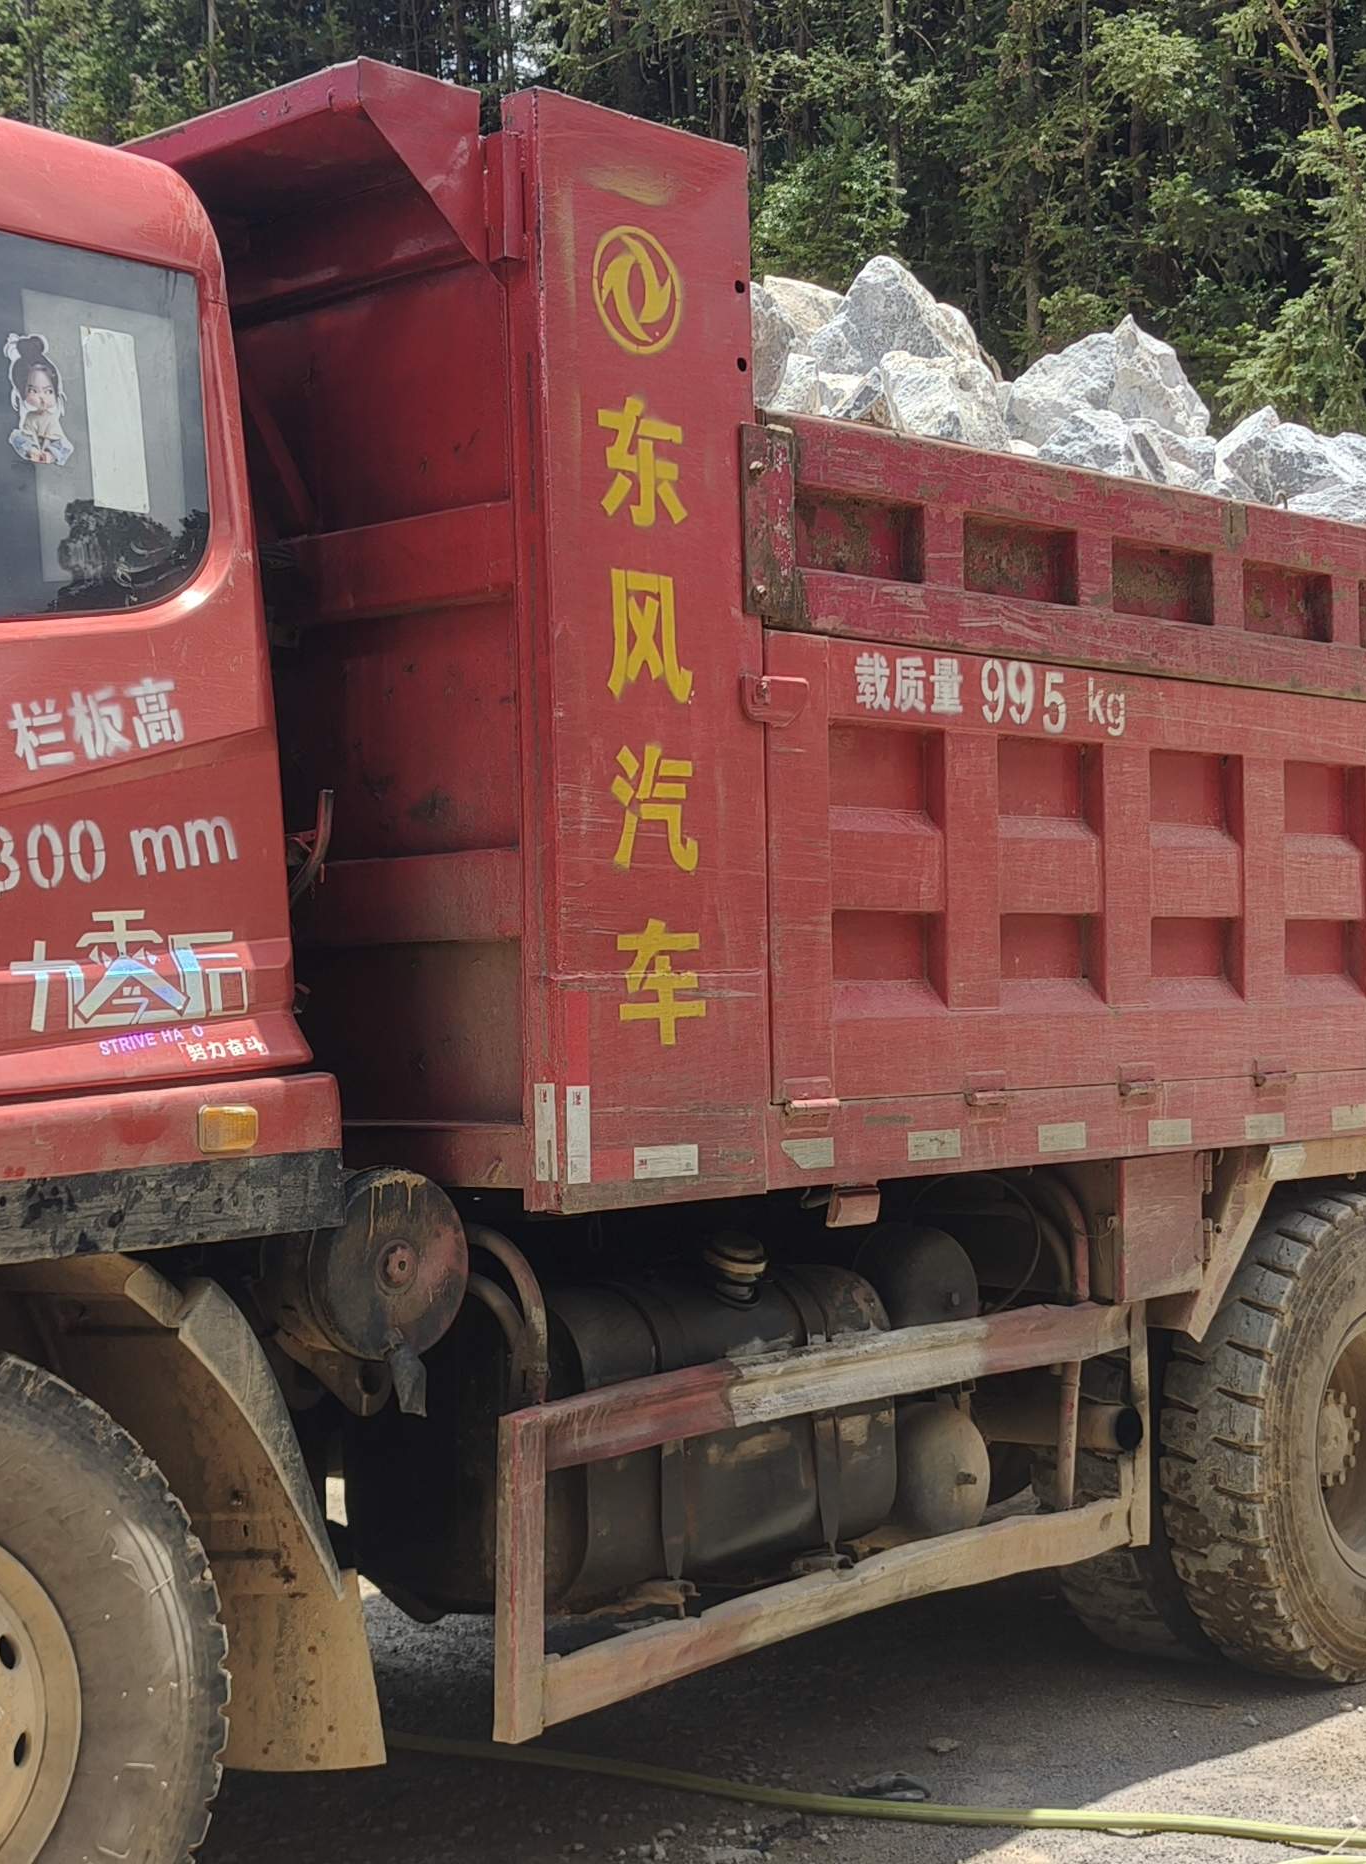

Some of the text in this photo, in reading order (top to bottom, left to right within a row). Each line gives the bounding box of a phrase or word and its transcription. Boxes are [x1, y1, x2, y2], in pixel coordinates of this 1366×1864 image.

[7, 677, 184, 771] 栏板高
[597, 396, 707, 1046] 东风汽车
[854, 652, 1126, 737] 载质量 995 kg
[129, 815, 238, 877] mm
[99, 1032, 157, 1056] STRIVE
